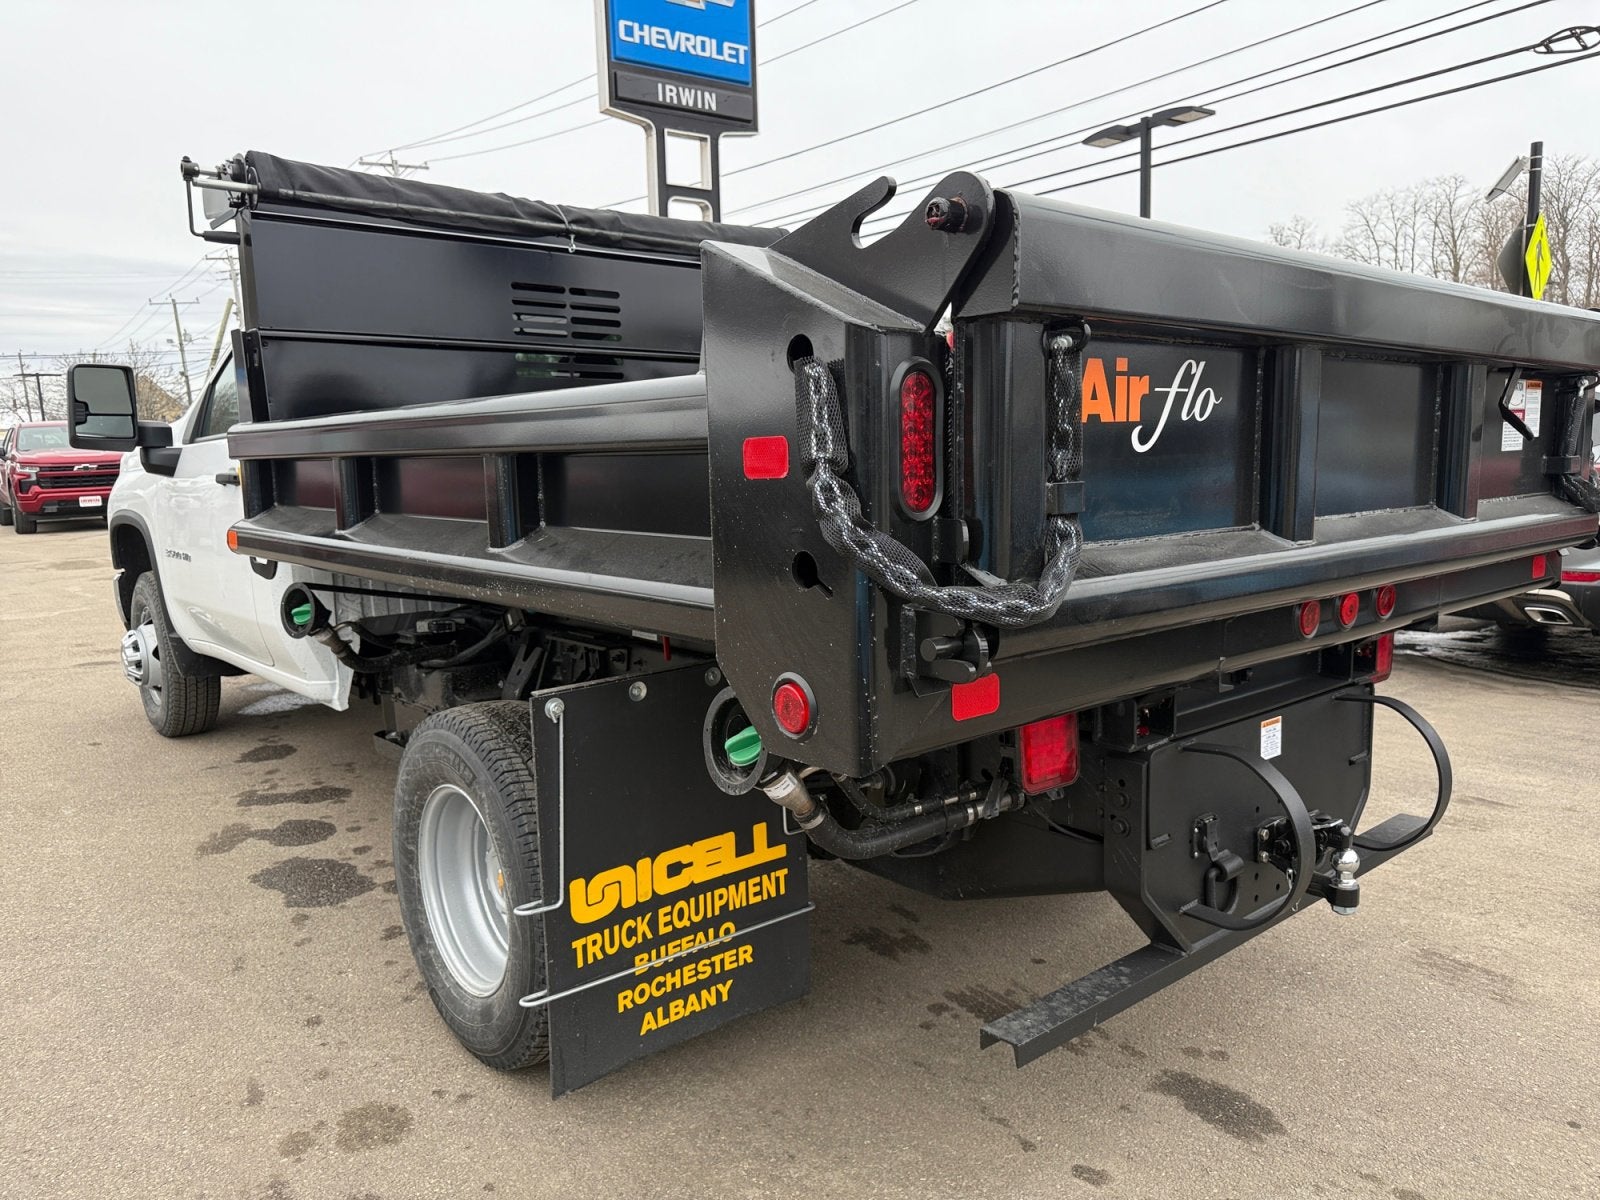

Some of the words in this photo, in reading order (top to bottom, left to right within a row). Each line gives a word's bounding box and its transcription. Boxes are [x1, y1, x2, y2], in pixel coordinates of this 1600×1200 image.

[618, 19, 749, 65] CHEVROLET
[657, 82, 717, 112] IRWIN
[1081, 357, 1150, 424] Air
[569, 822, 787, 924] UNICELL
[571, 912, 653, 969] TRUCK
[658, 868, 788, 936] EQUIPMENT
[634, 921, 736, 976] BUFFALO
[617, 944, 753, 1014] ROCHESTER
[639, 979, 733, 1036] ALBANY
